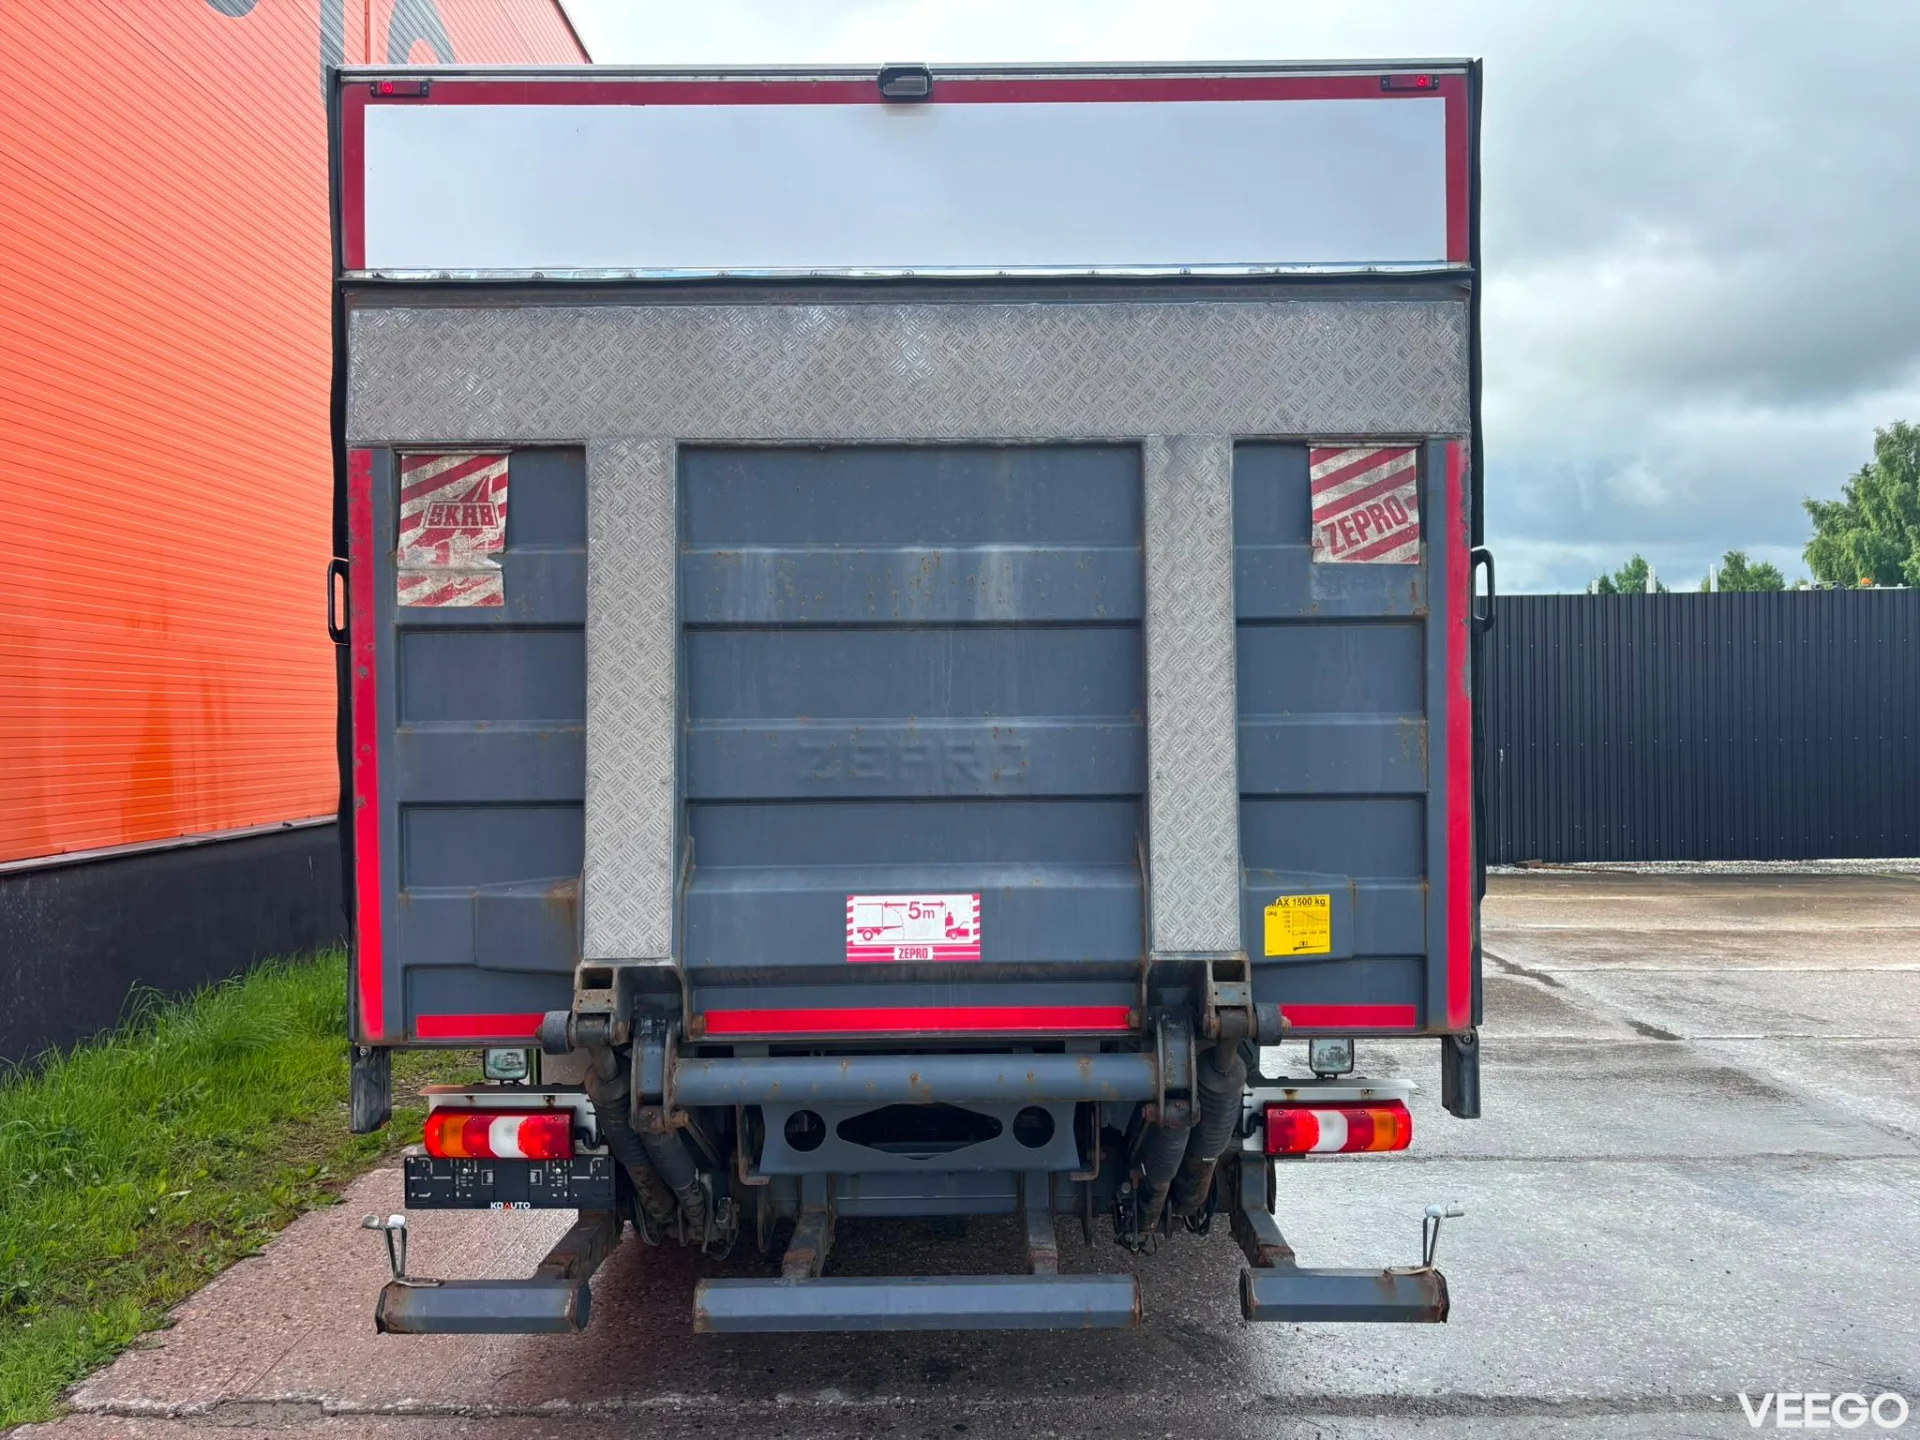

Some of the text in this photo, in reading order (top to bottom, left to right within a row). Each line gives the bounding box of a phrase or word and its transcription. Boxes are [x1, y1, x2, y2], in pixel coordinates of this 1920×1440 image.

[1321, 495, 1409, 556] ZEPRO
[1293, 897, 1313, 906] 1500
[1315, 897, 1326, 907] kg
[898, 948, 929, 959] ZEPRO
